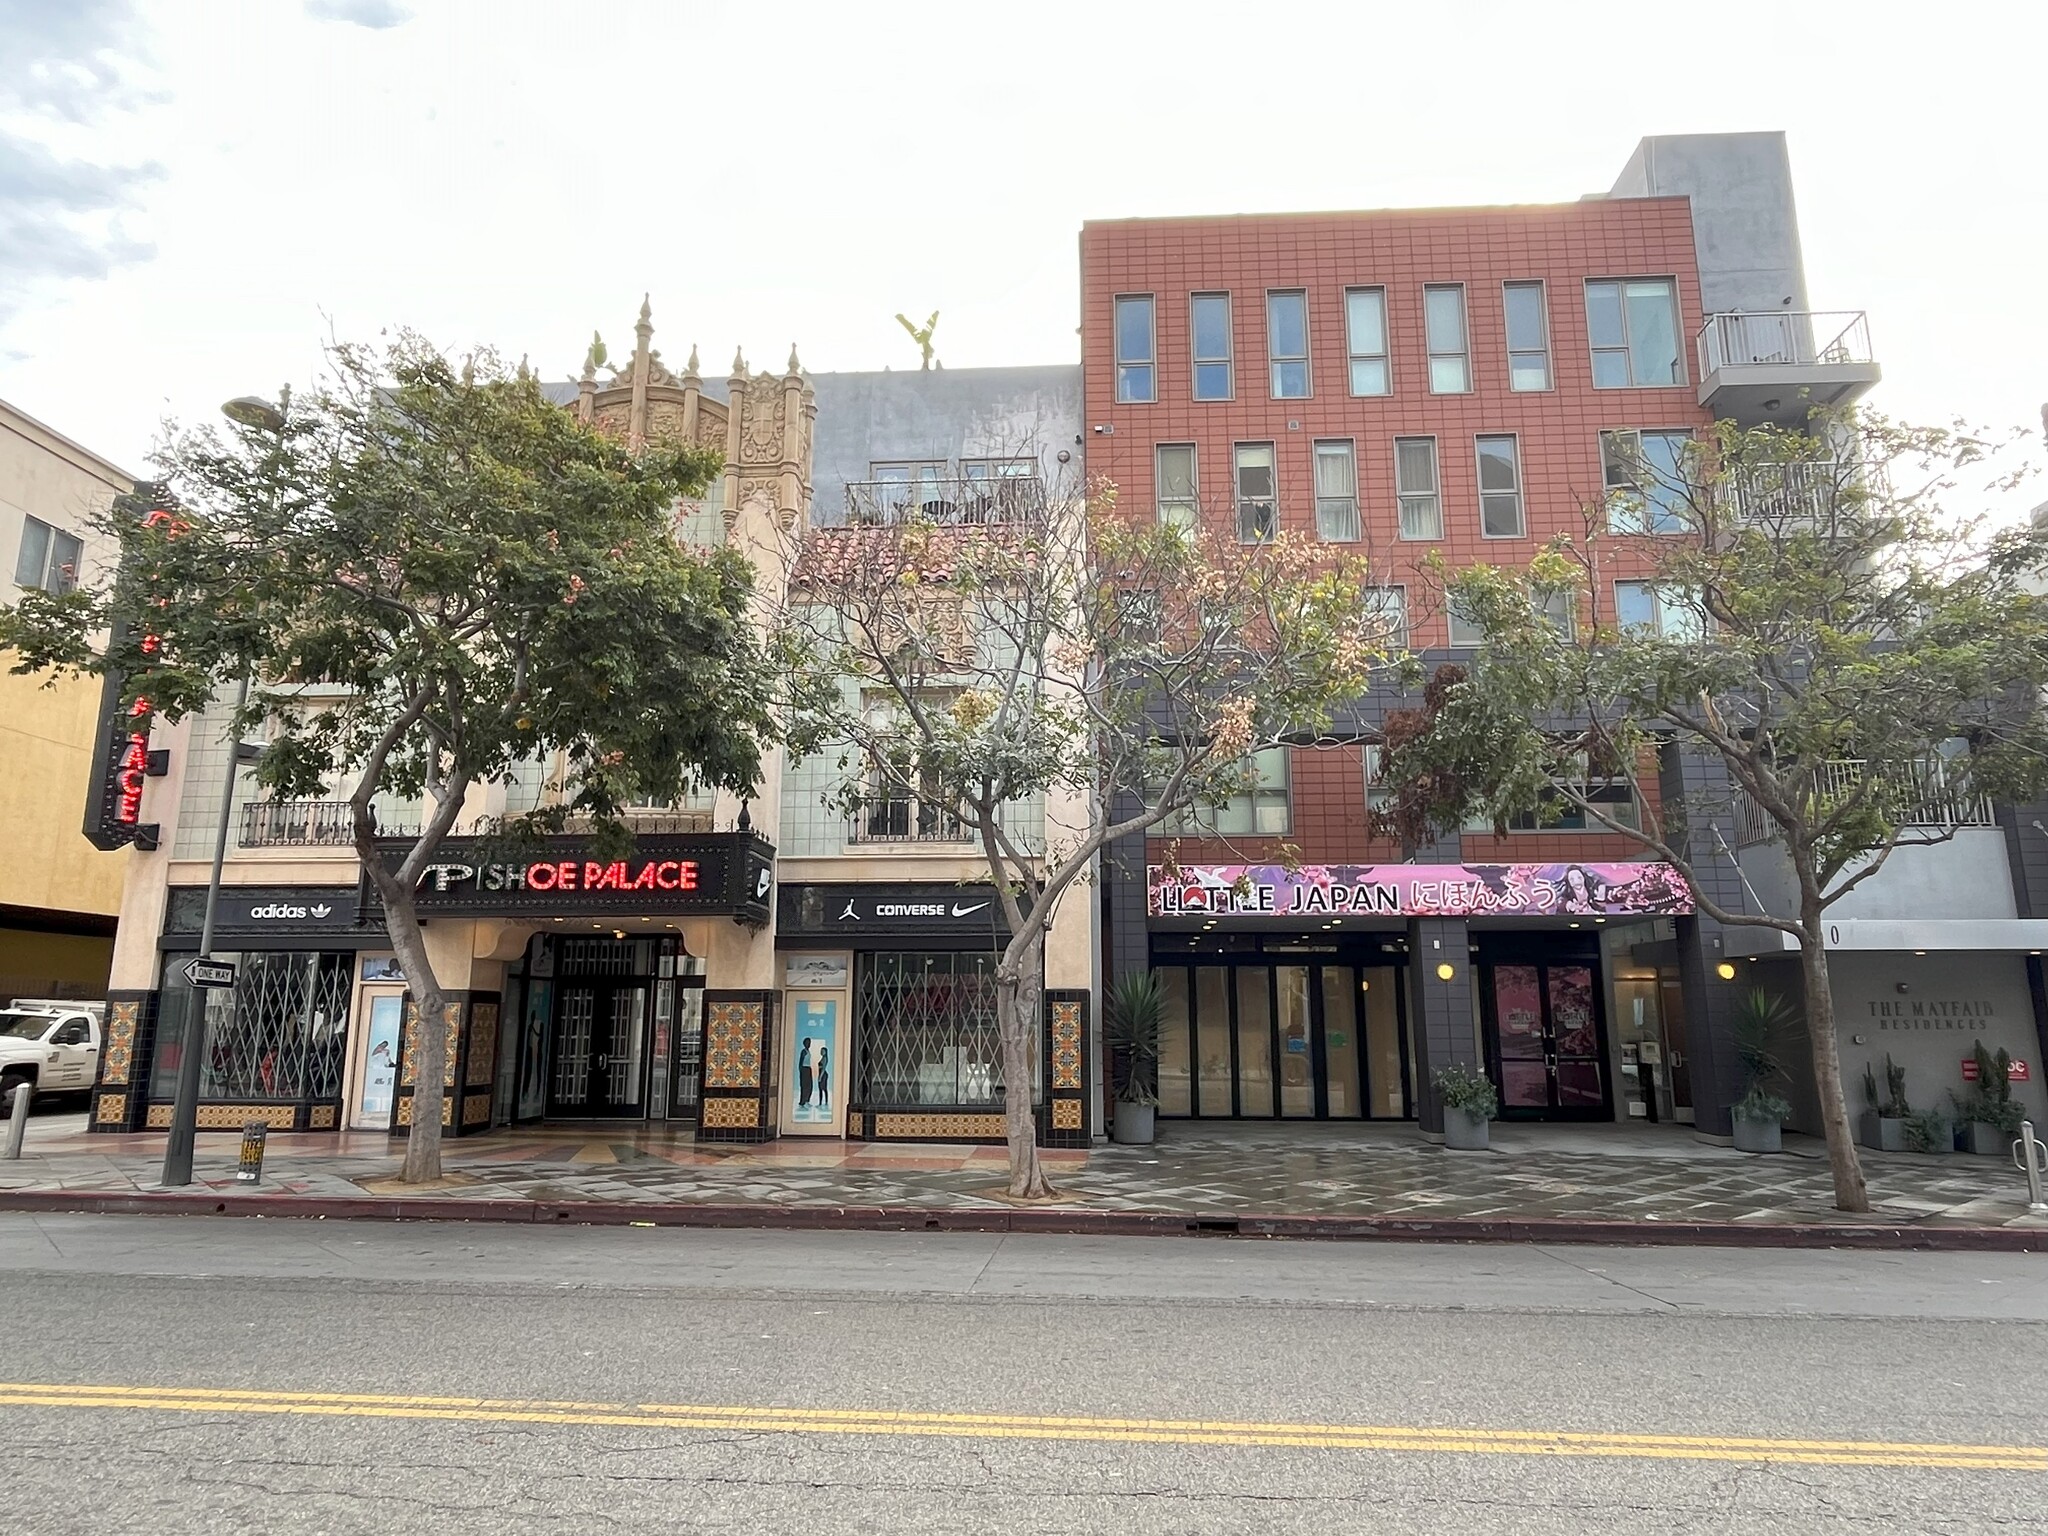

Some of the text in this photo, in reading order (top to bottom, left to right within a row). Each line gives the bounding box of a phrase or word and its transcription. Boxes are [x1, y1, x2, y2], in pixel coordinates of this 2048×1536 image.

[485, 863, 577, 890] SHOE
[584, 862, 697, 890] PALACE
[1291, 886, 1399, 911] JAPAN
[1411, 879, 1556, 909] にほんふう
[250, 903, 307, 919] adidas
[876, 904, 945, 916] CONVERSE
[199, 966, 231, 981] ONE WAY
[1867, 1001, 1994, 1017] THE MAYFAIR
[1880, 1019, 1987, 1031] RESIDENCES
